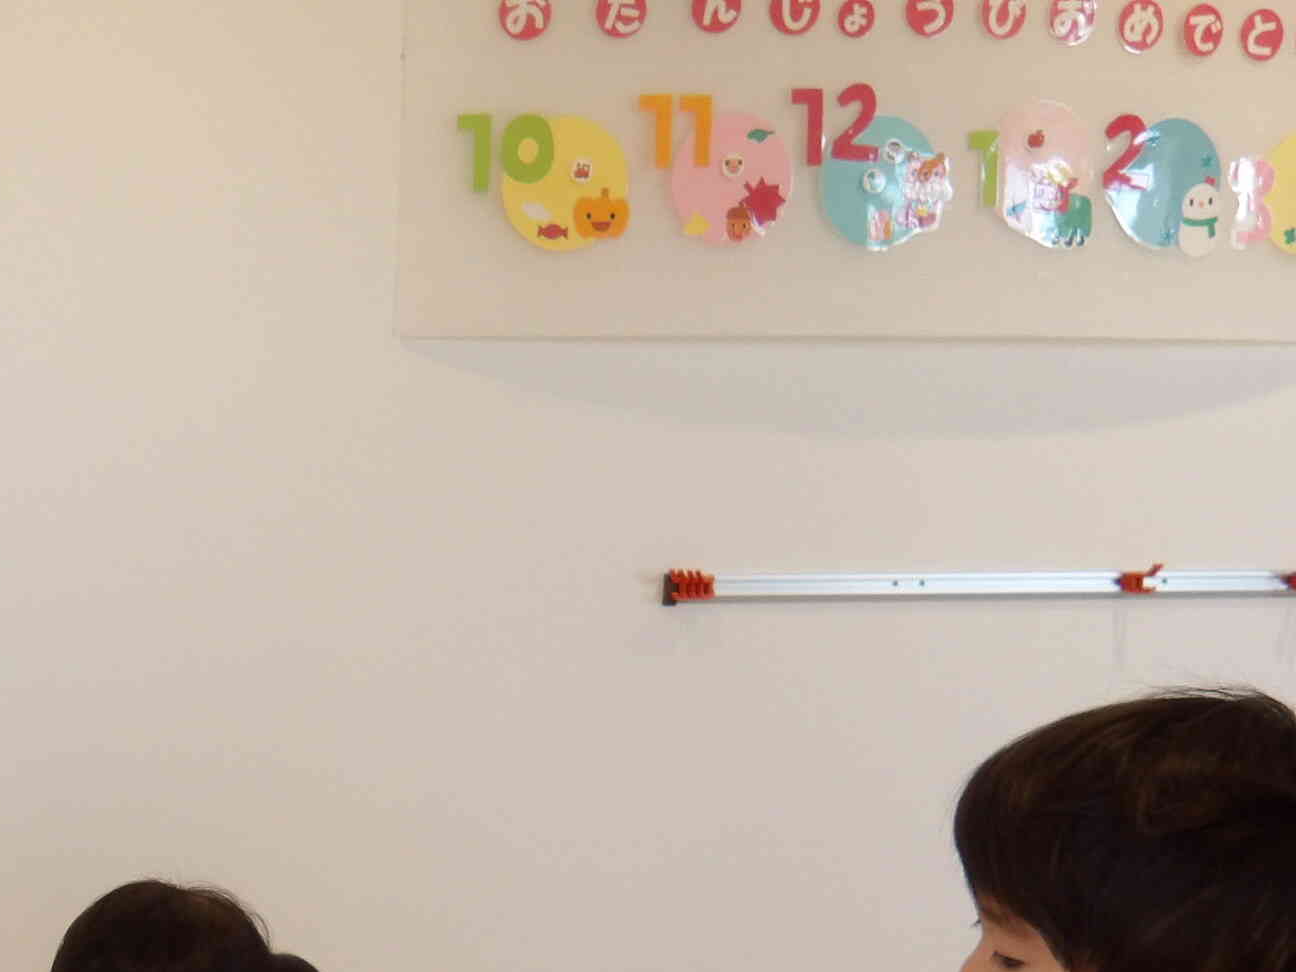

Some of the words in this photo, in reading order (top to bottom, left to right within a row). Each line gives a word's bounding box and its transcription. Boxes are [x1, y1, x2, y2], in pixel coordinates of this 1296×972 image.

[457, 113, 554, 193] 10
[638, 93, 712, 169] 11
[791, 83, 880, 167] 12
[967, 129, 1000, 207] 1
[1102, 114, 1147, 190] 2
